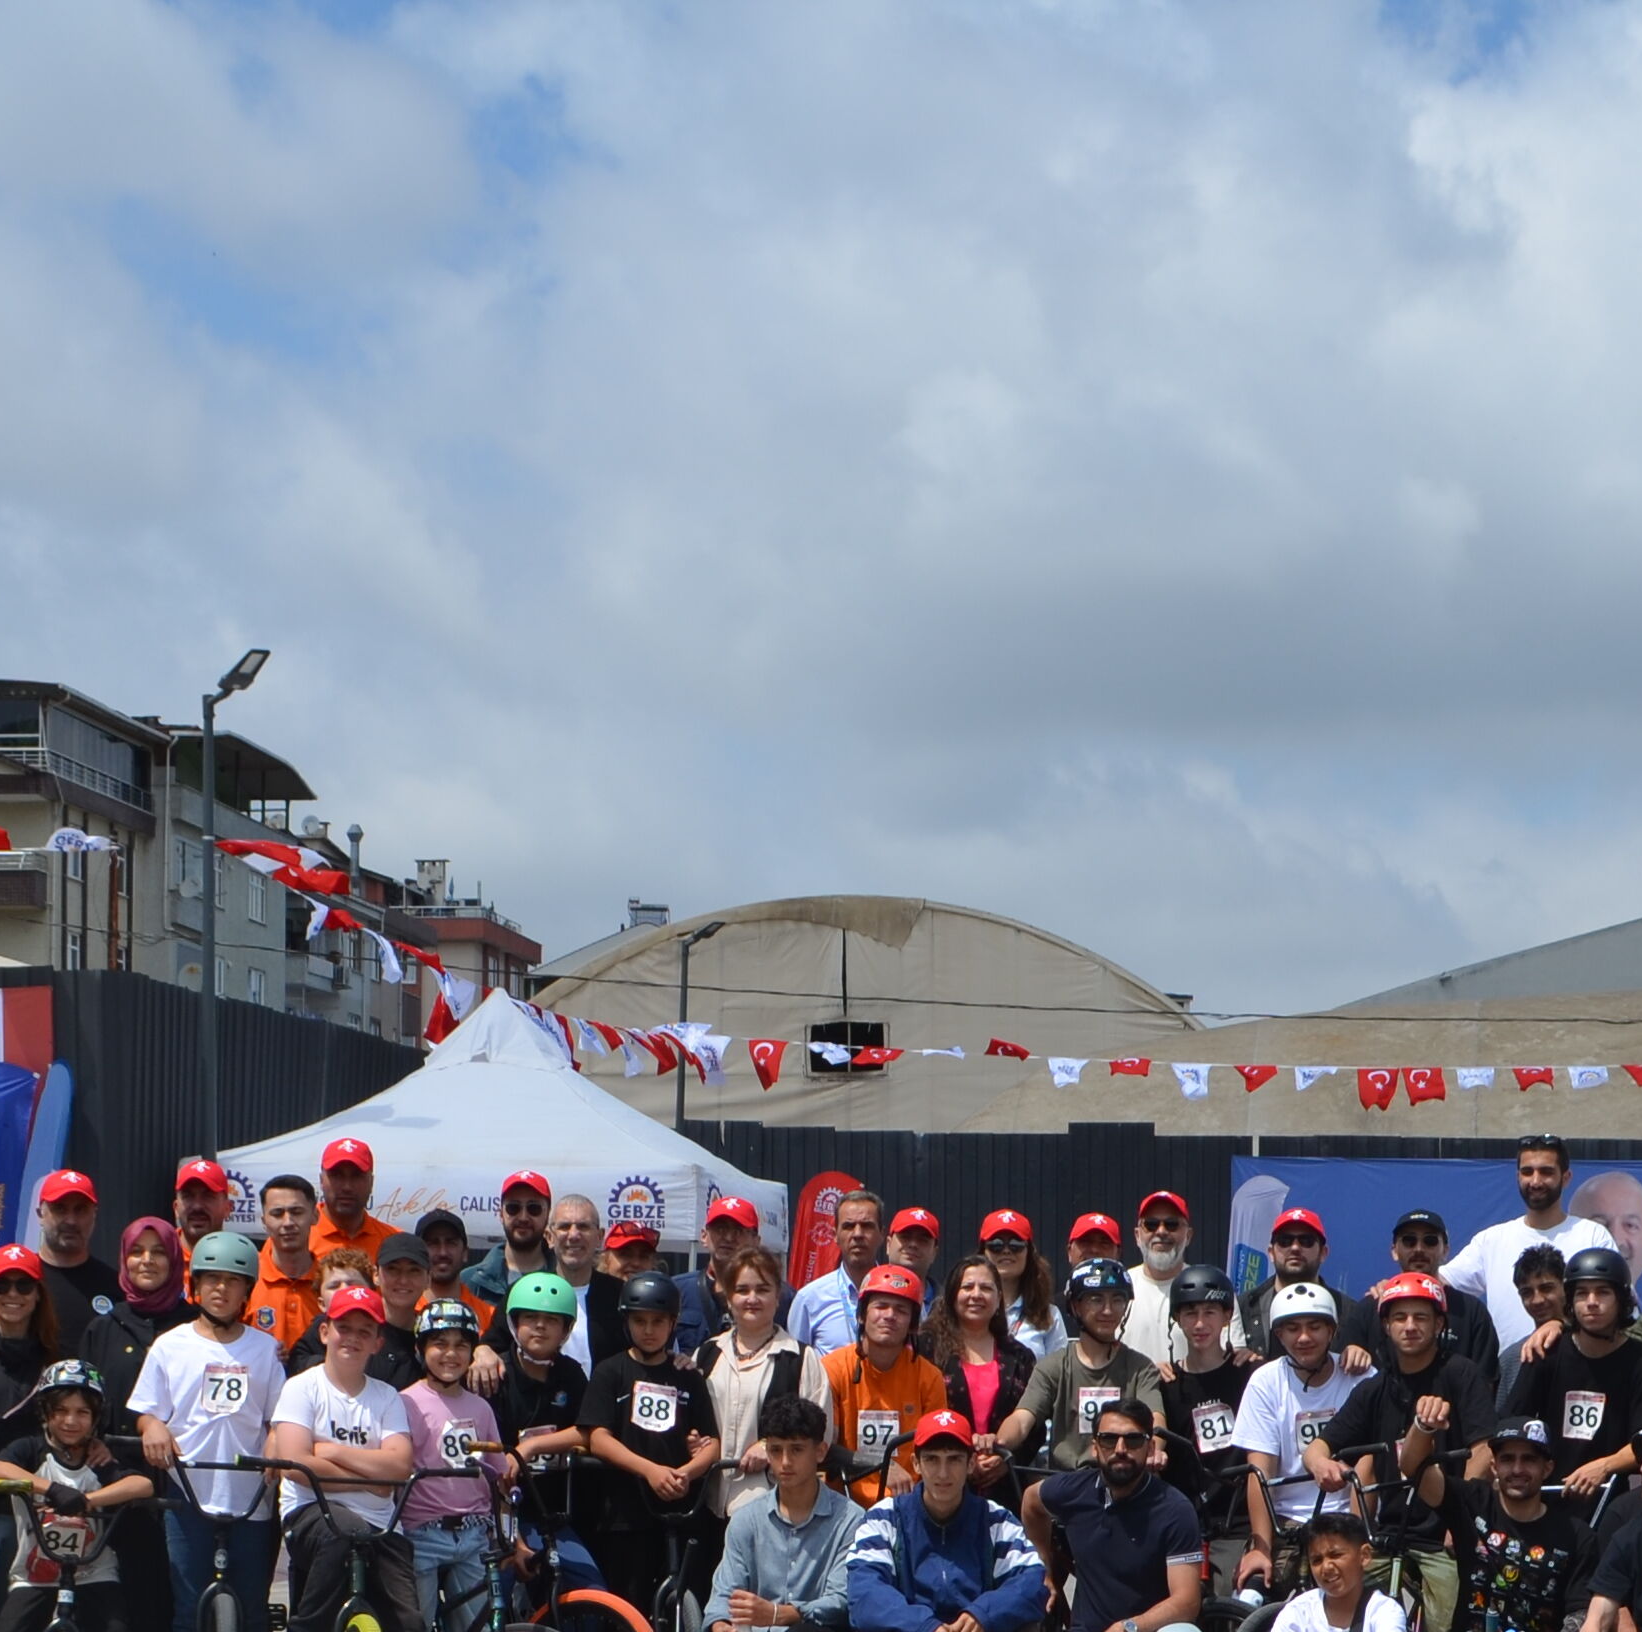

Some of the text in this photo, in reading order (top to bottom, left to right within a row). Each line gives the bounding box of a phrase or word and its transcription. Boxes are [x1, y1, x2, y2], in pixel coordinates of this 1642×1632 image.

[608, 1205, 665, 1219] GEBZE
[207, 1378, 242, 1401] 78
[638, 1396, 670, 1421] 88
[1084, 1401, 1099, 1424] 9
[1569, 1405, 1598, 1427] 86
[331, 1420, 368, 1445] levi's
[862, 1424, 893, 1447] 97
[1201, 1416, 1234, 1441] 81
[44, 1530, 78, 1552] 84
